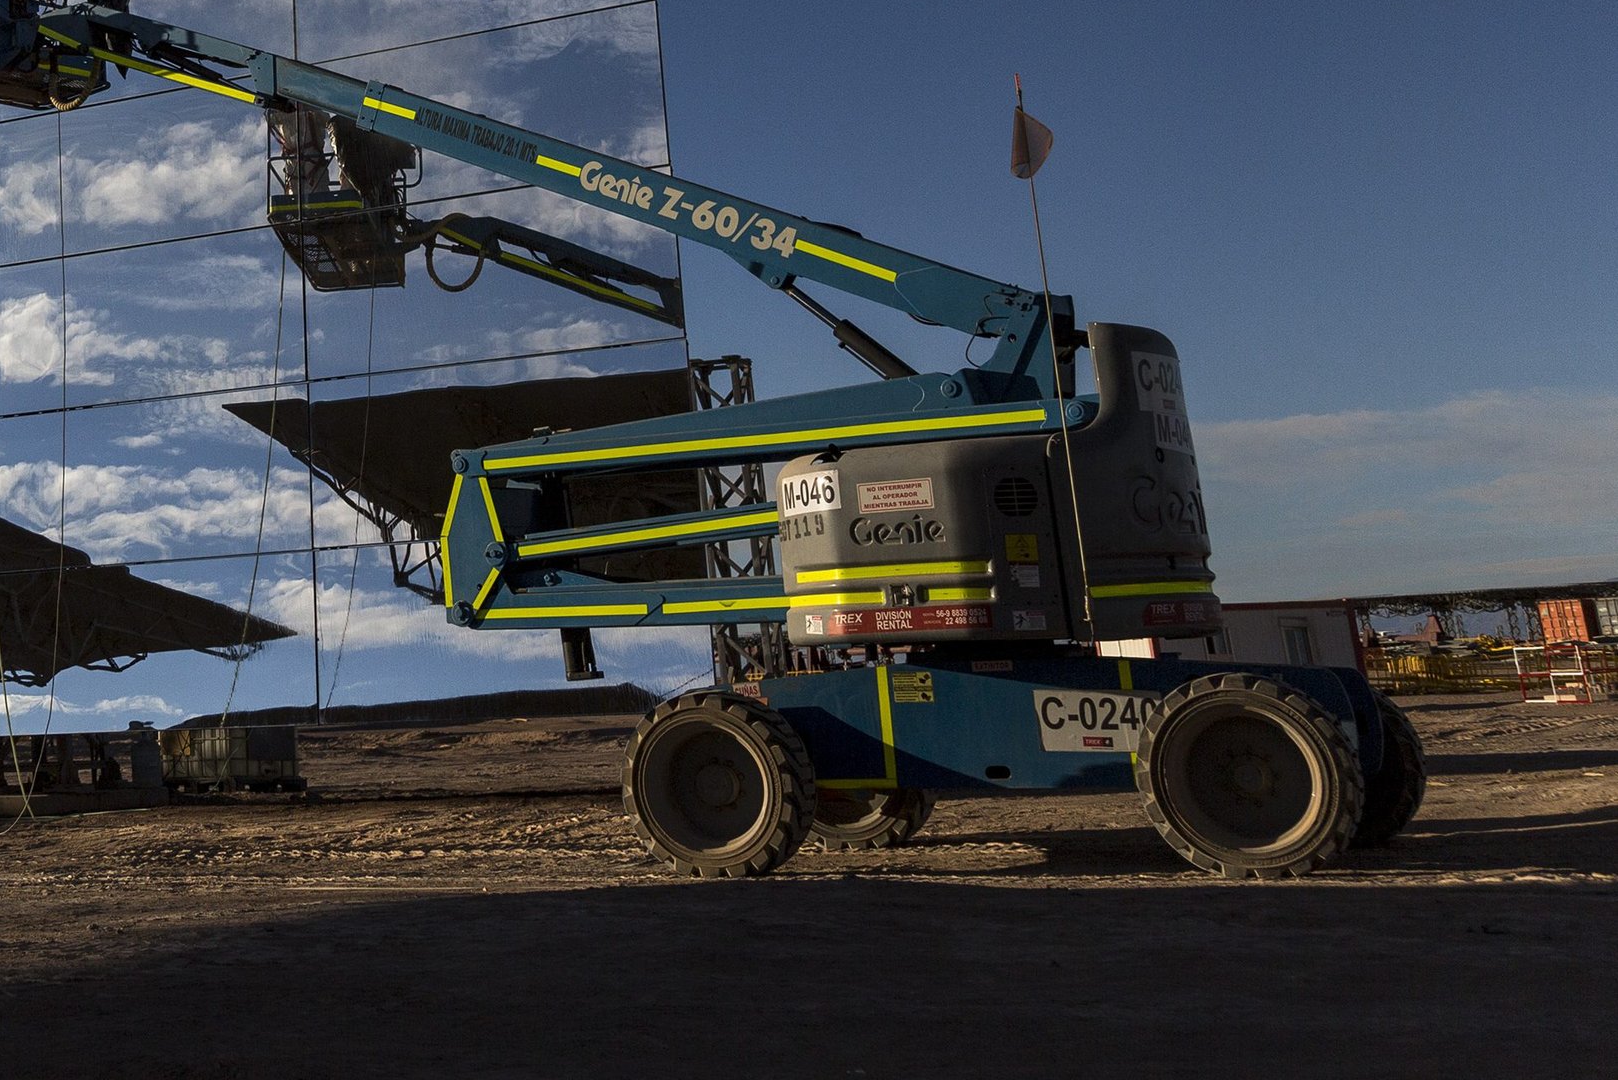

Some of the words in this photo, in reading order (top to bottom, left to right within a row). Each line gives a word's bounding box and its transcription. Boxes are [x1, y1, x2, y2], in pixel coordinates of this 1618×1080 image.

[414, 106, 444, 133] ALTURA
[442, 115, 471, 142] MAXIMA
[471, 124, 506, 153] TRABAJO
[580, 160, 654, 210] Genie
[657, 185, 797, 258] Z-60/34
[783, 475, 835, 510] M-046
[877, 482, 922, 492] INTERRUMPIR
[882, 491, 918, 500] OPERADOR
[863, 501, 897, 509] MIENTRAS
[898, 499, 929, 507] TRABAJA
[849, 514, 946, 546] Genie
[834, 612, 863, 625] TREX
[875, 608, 912, 620] DIVISIÓN
[935, 609, 951, 618] 56-9
[876, 619, 913, 631] RENTAL
[944, 617, 954, 625] 22
